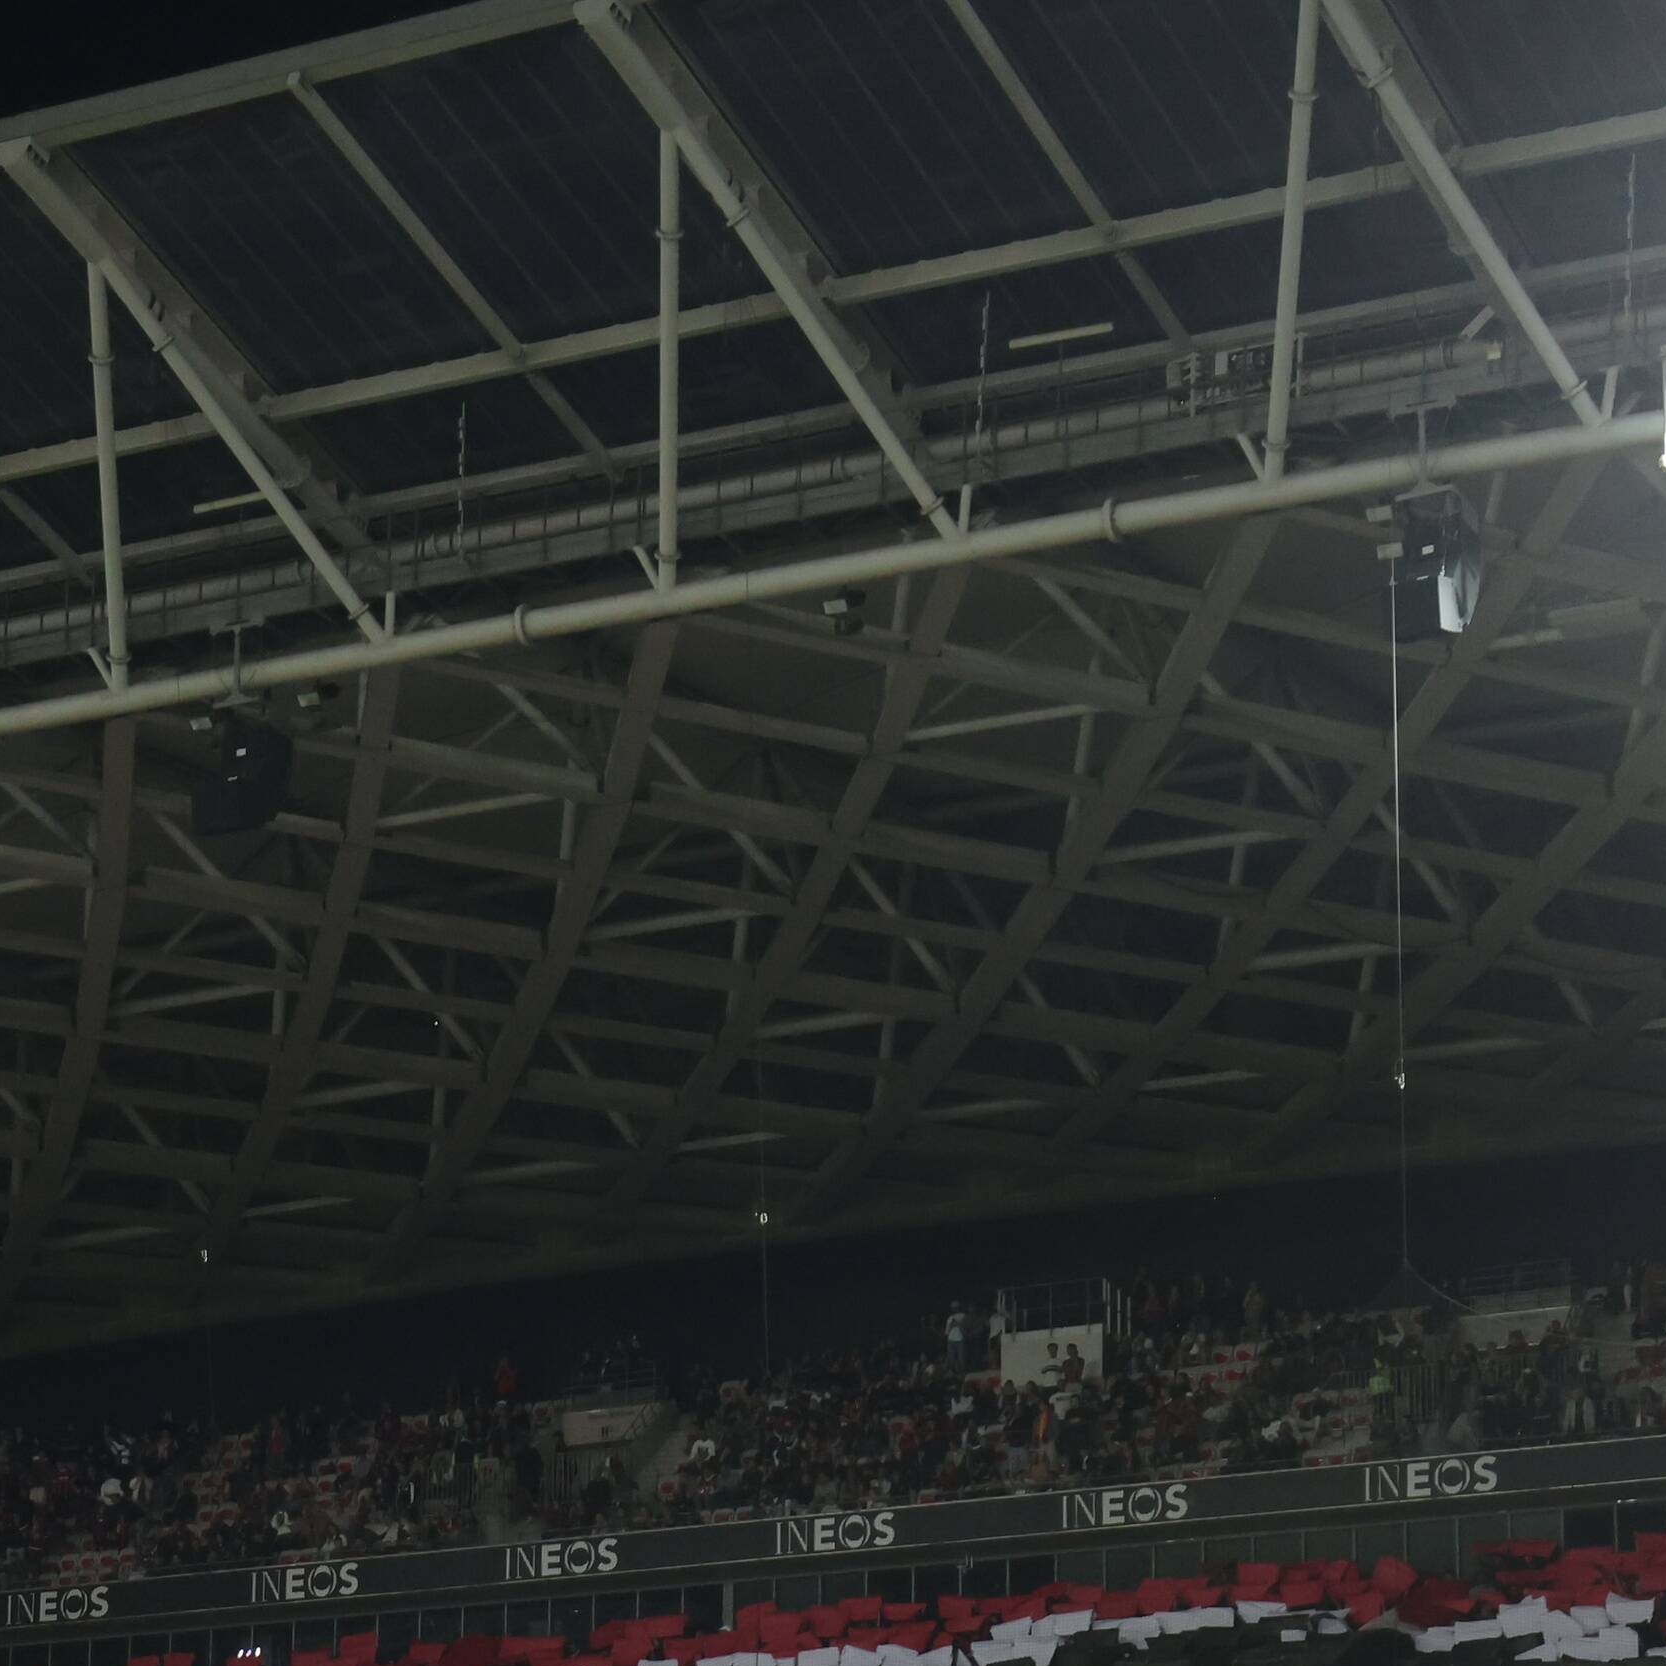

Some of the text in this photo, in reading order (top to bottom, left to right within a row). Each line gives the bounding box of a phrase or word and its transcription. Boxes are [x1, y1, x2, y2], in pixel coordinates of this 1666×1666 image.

[1364, 1455, 1498, 1501] INEOS
[1061, 1484, 1189, 1529] INEOS
[775, 1511, 895, 1555] INEOS
[505, 1538, 618, 1580] INEOS
[250, 1562, 360, 1604] INEOS
[6, 1586, 109, 1625] INEOS
